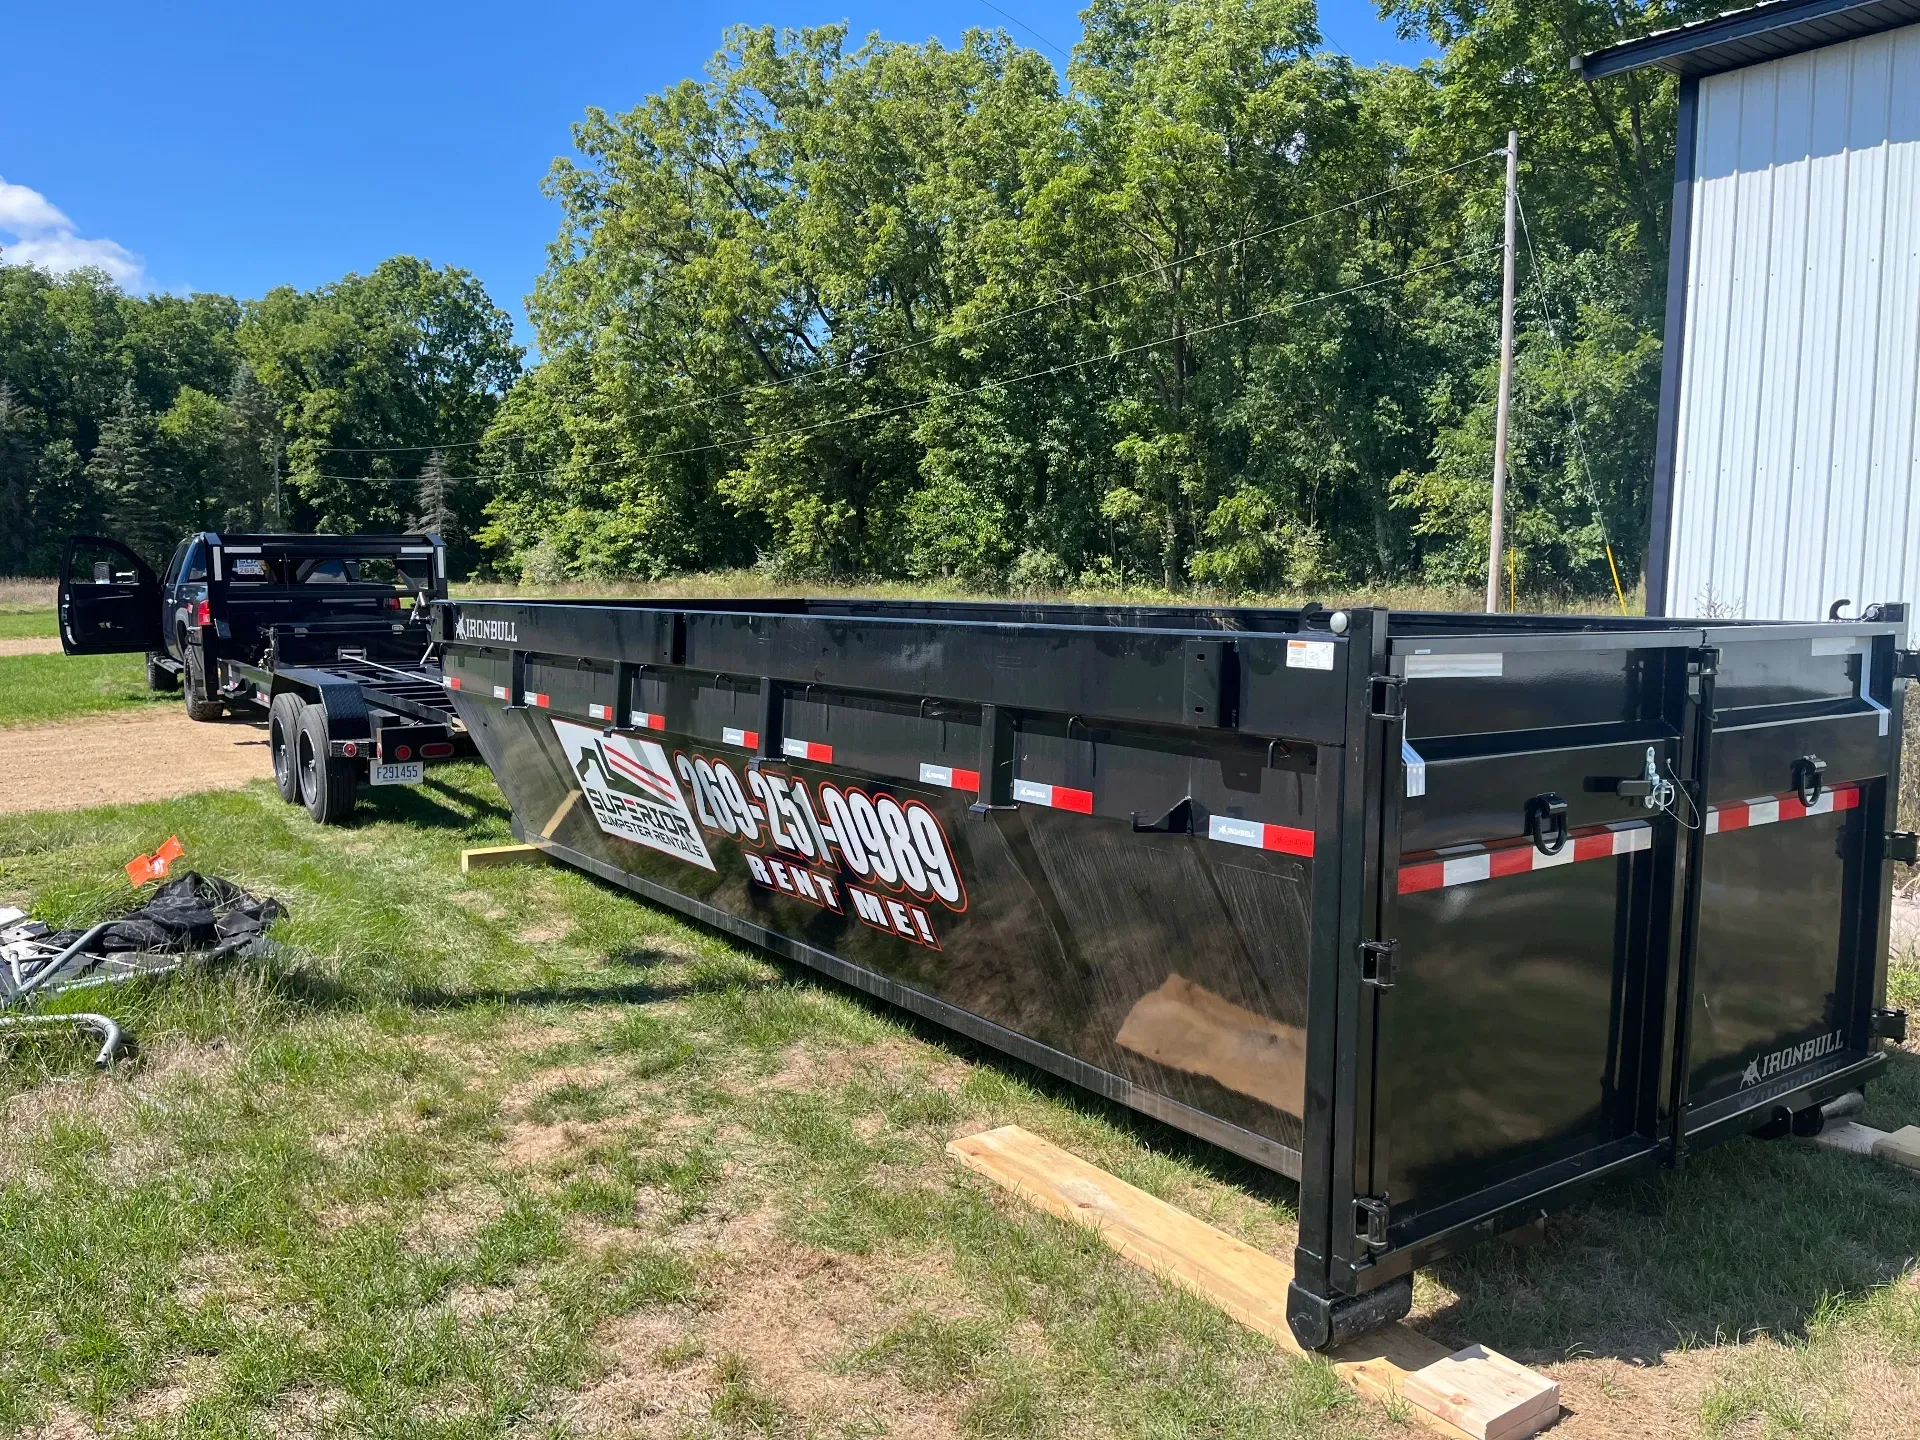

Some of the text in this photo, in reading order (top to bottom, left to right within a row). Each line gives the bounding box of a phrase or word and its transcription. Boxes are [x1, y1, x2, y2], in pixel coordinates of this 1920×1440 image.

[466, 618, 518, 642] IRONBULL
[376, 765, 418, 780] F291455
[586, 787, 696, 842] SUPERIOR
[597, 812, 704, 858] DUMPSTER RENTALS
[675, 753, 960, 903] 269-251-0989
[744, 853, 935, 943] RENT ME!
[1761, 1029, 1844, 1078] IRONBULL
